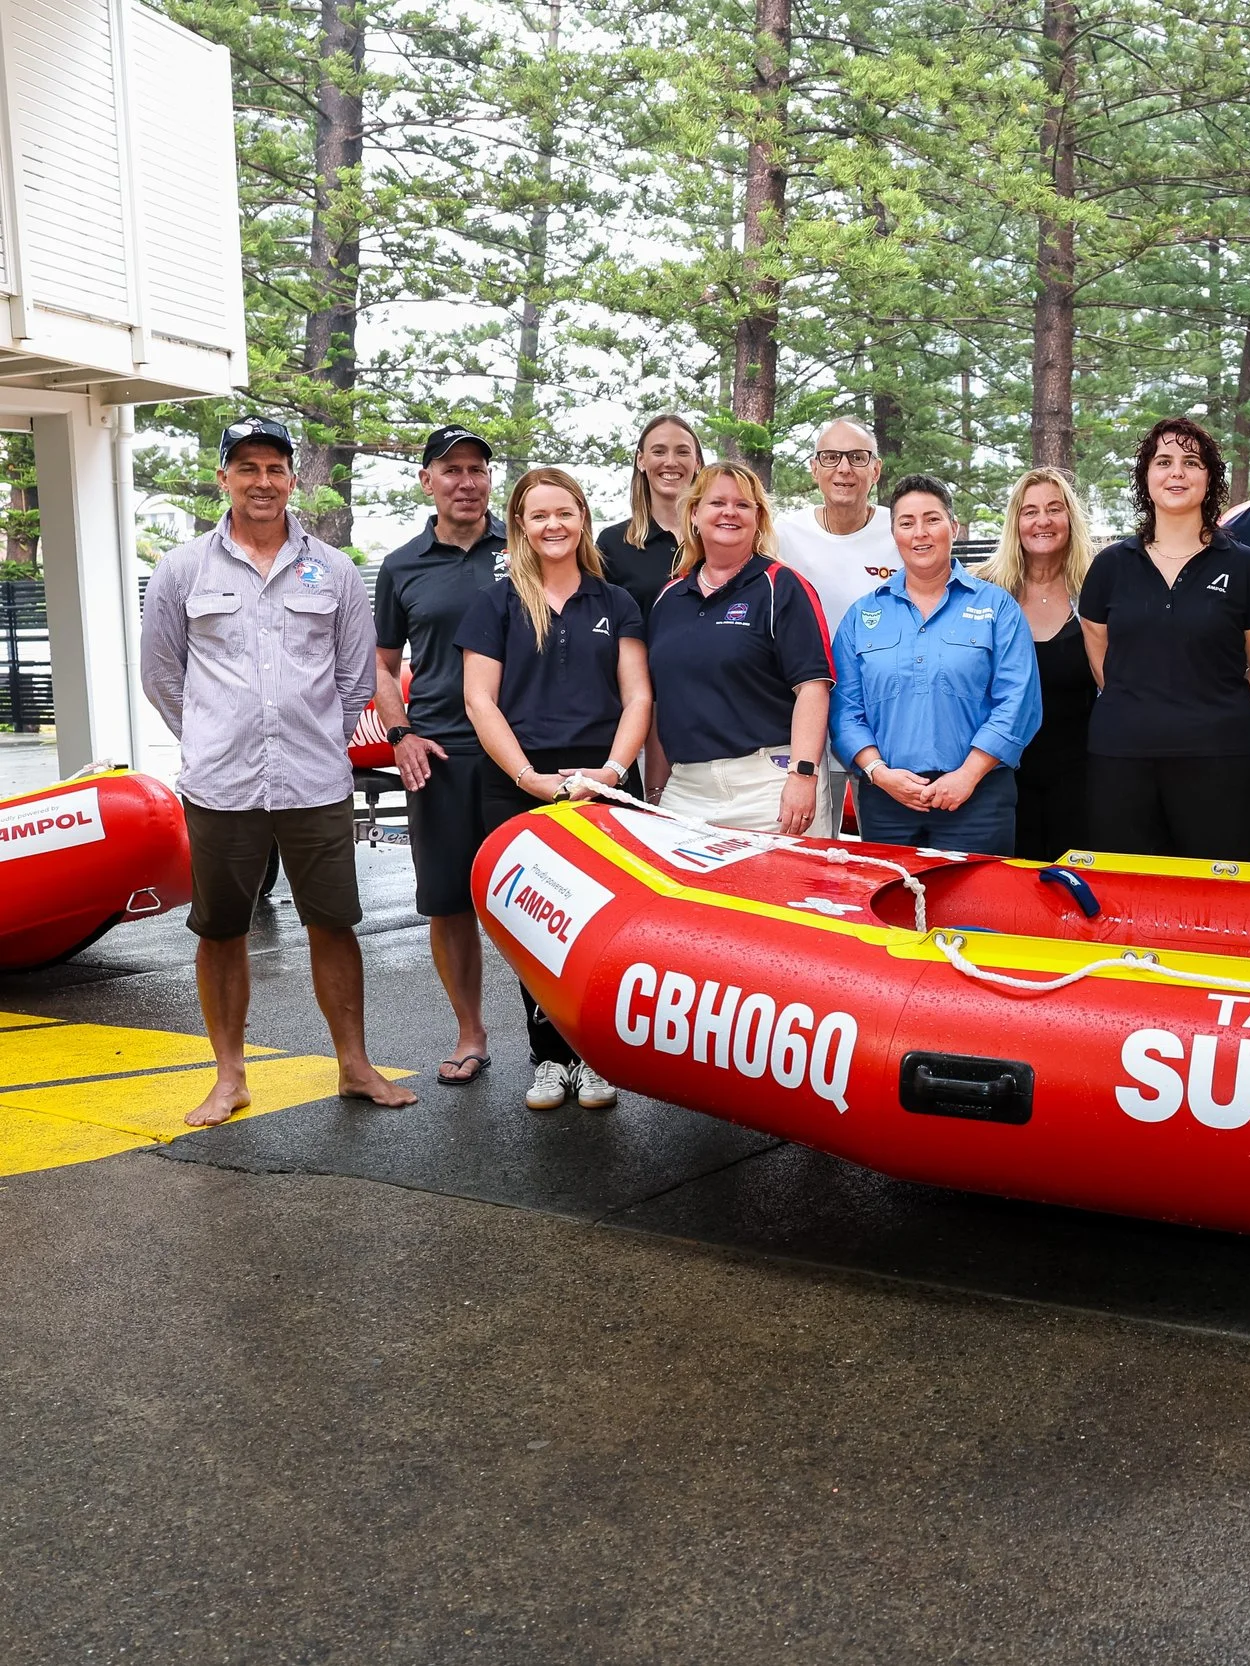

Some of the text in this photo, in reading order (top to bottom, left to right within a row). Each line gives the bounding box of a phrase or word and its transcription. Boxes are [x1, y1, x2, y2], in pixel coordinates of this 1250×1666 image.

[17, 806, 49, 820] powered
[531, 863, 575, 900] Proudly powered by
[514, 885, 573, 944] AMPOL
[615, 962, 859, 1115] CBH06Q
